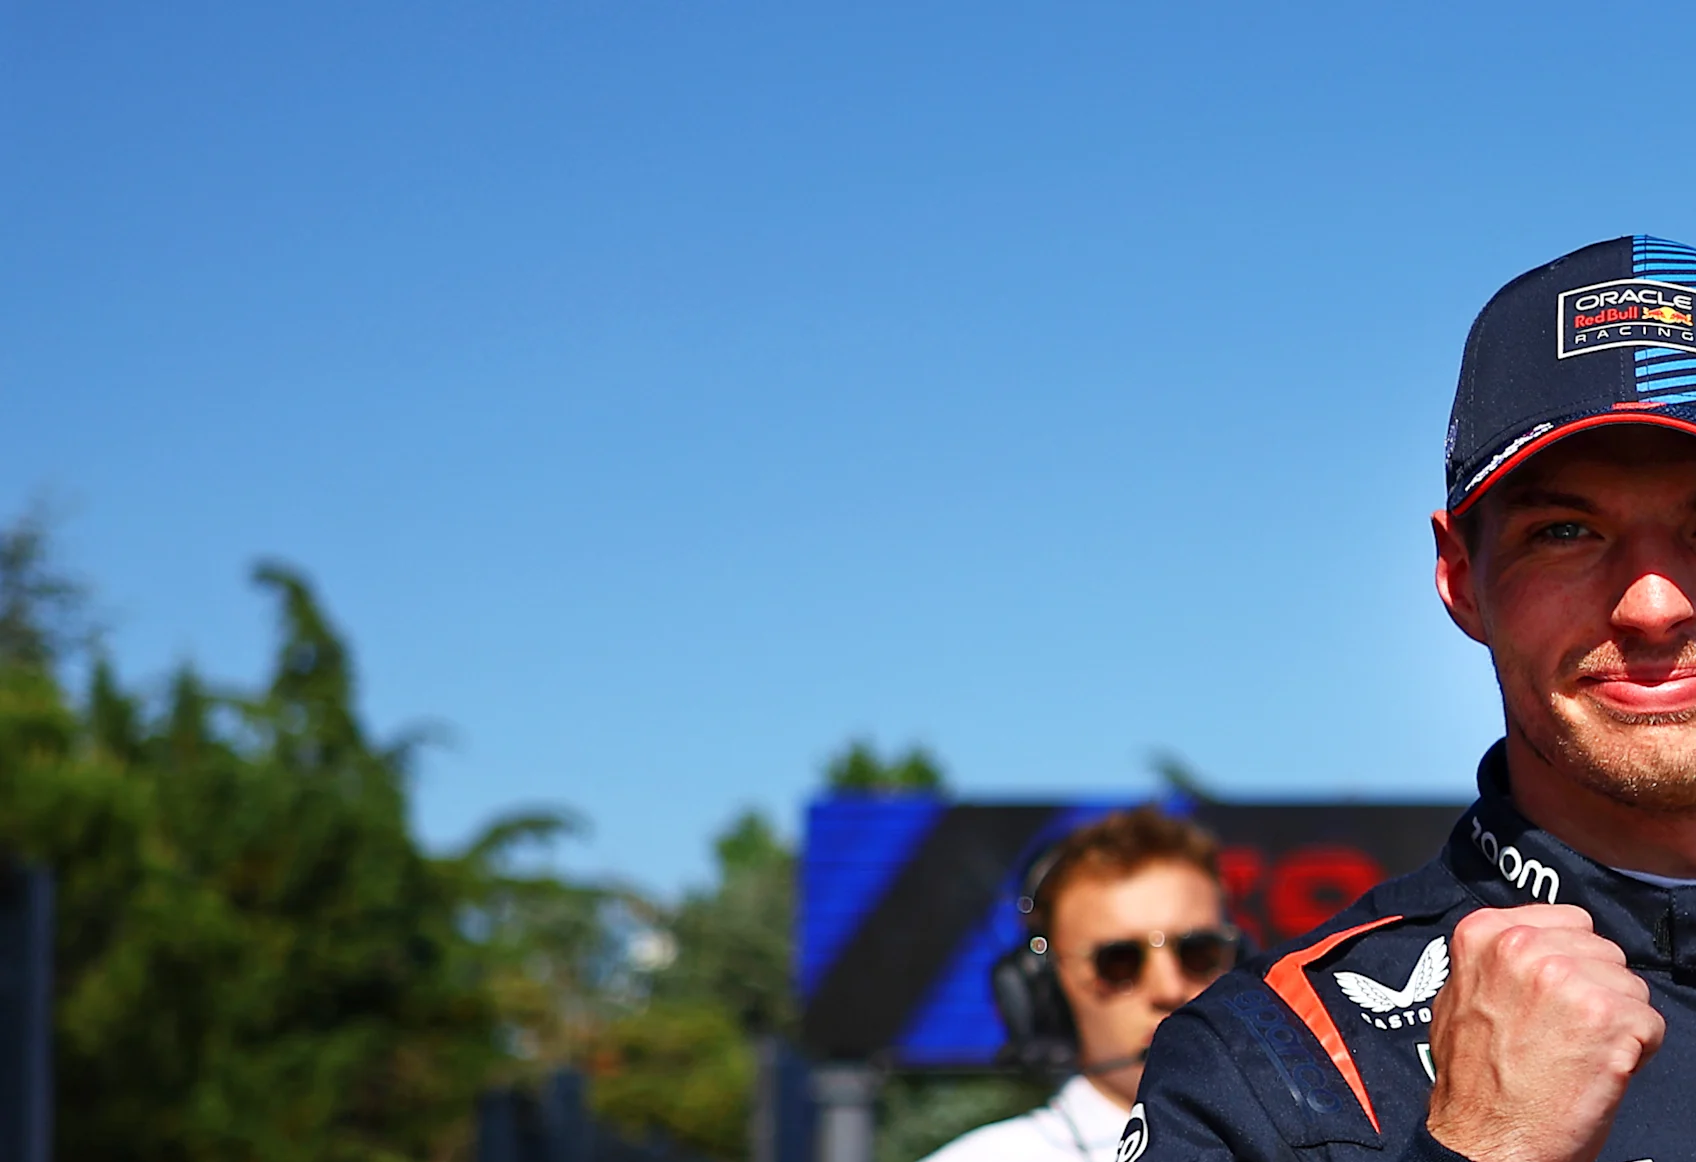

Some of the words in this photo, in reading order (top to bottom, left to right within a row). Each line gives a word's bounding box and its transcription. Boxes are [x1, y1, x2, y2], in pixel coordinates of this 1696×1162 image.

[1575, 288, 1693, 311] ORACLE
[1575, 325, 1694, 344] RACING
[1472, 816, 1559, 905] zoom
